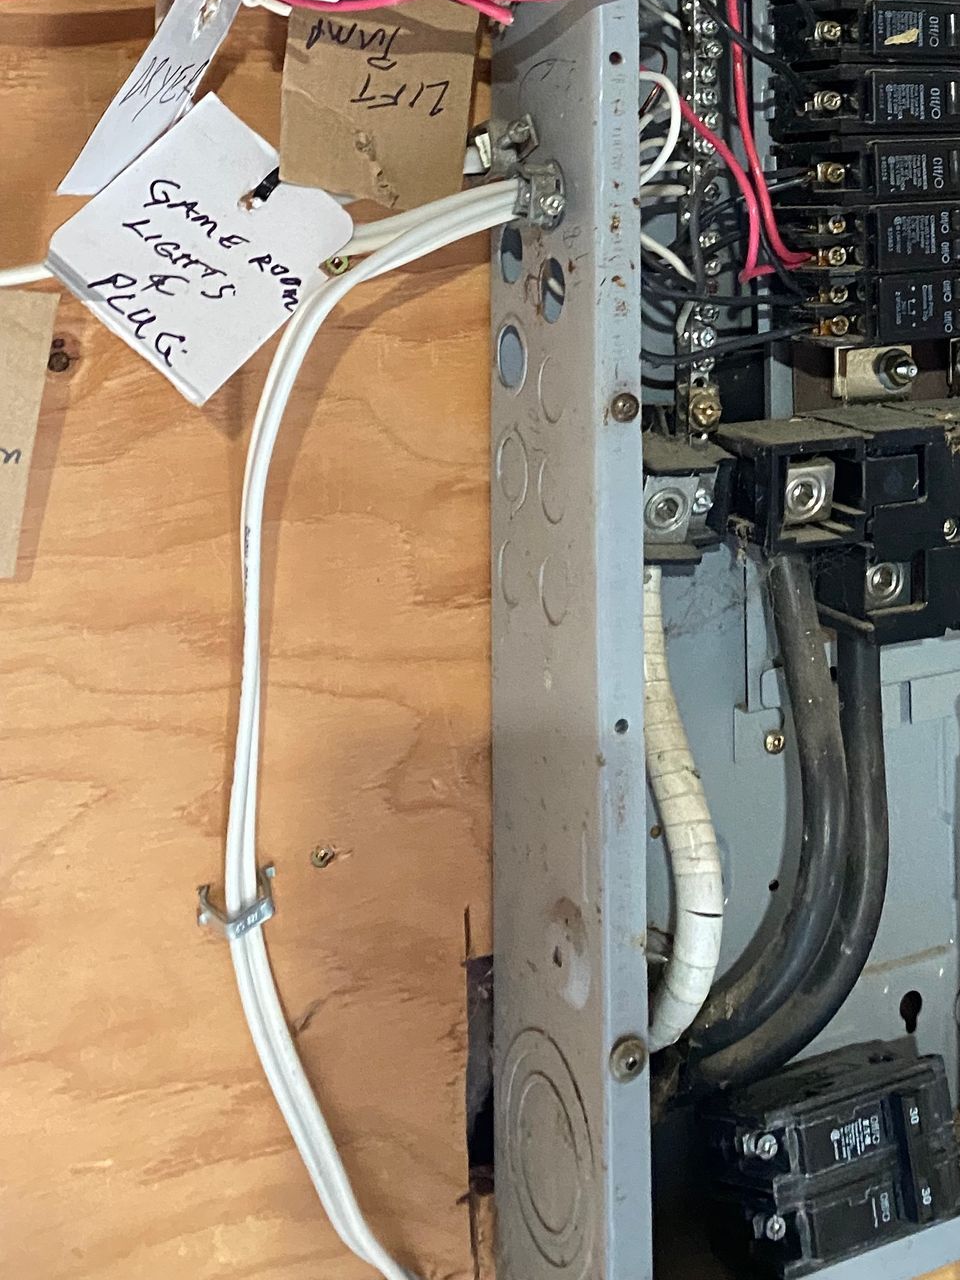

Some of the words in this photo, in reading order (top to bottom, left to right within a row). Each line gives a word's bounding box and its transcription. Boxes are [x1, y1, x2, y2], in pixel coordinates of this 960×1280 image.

[306, 18, 401, 70] PUMP
[119, 56, 210, 122] DRYER
[350, 74, 449, 117] LIFT
[122, 219, 236, 299] LIGHTS
[143, 179, 250, 249] GAME
[249, 253, 303, 313] ROOM
[909, 1106, 919, 1125] 30
[921, 1186, 932, 1206] 30
